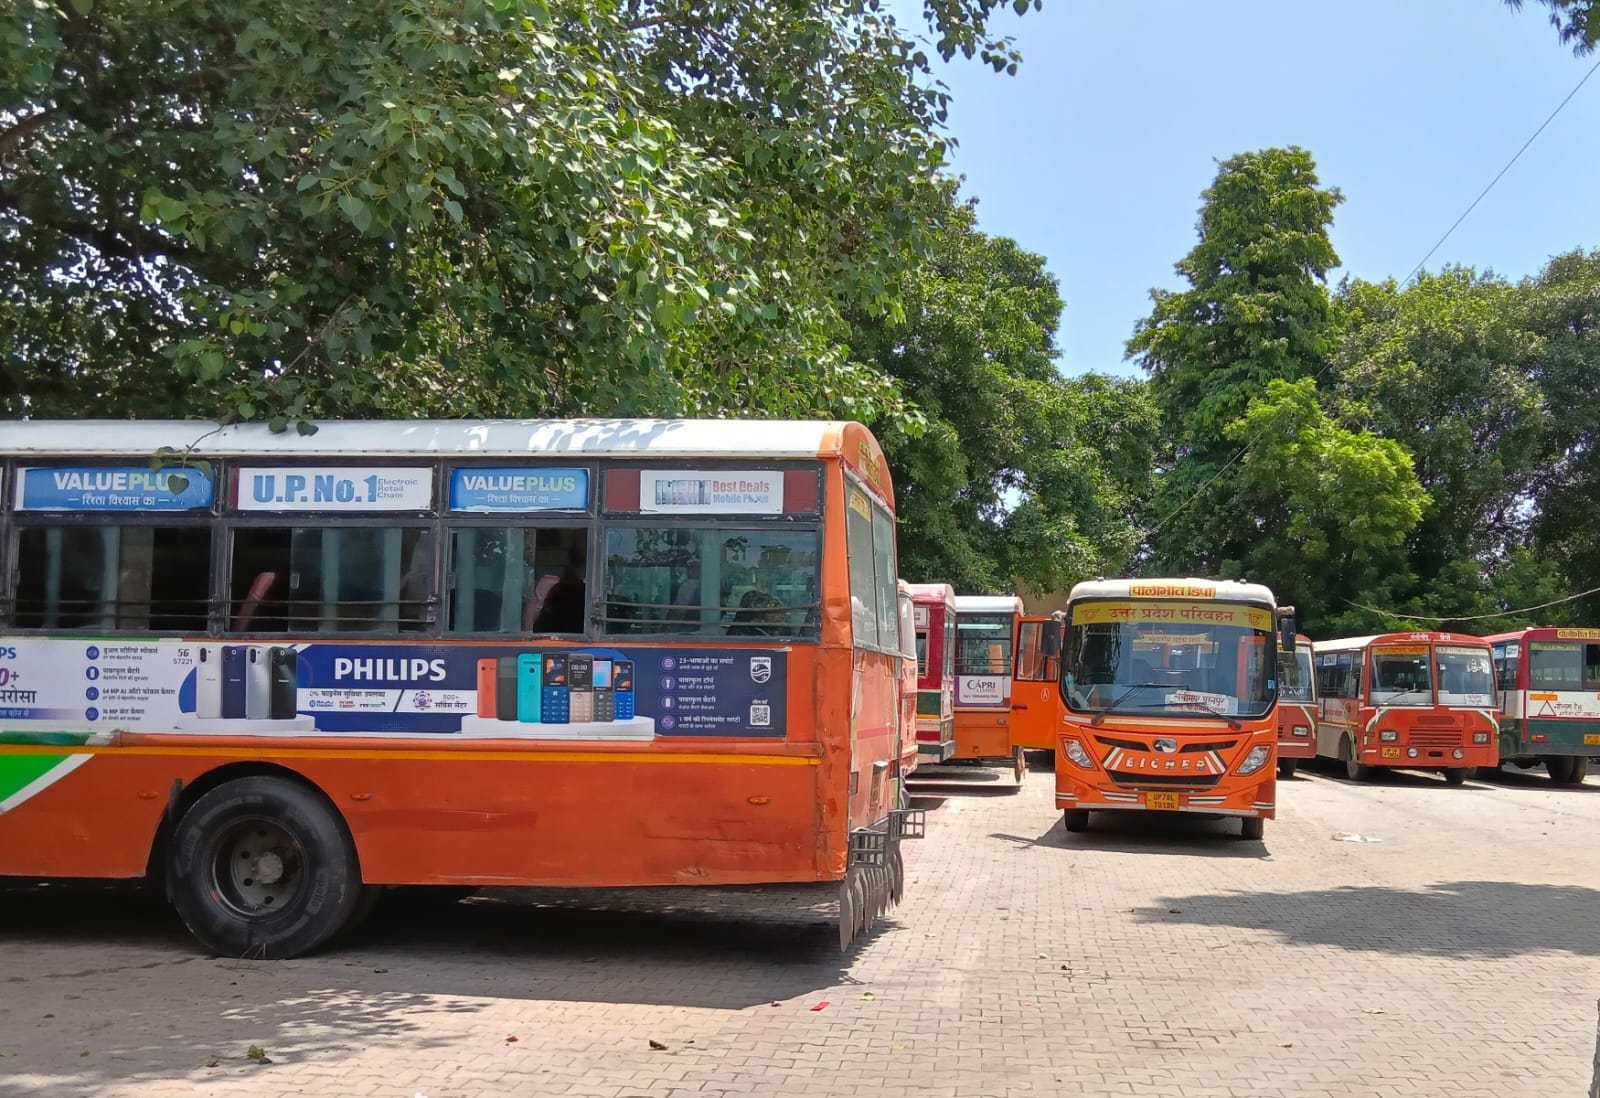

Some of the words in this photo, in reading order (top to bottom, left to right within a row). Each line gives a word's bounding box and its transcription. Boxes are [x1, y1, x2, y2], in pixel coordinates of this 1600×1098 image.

[53, 472, 188, 491] VALUEPLU
[463, 475, 576, 492] VALUEPLUS
[712, 480, 737, 493] Best
[739, 480, 770, 493] Deals
[377, 485, 404, 493] Retail
[712, 494, 742, 503] Mobile
[1109, 607, 1136, 620] उत्तर
[1142, 605, 1176, 621] प्रदेश
[1179, 605, 1235, 622] परिवहन
[177, 648, 190, 657] 5G
[335, 658, 447, 681] PHILIPS
[1126, 756, 1206, 770] EICHER
